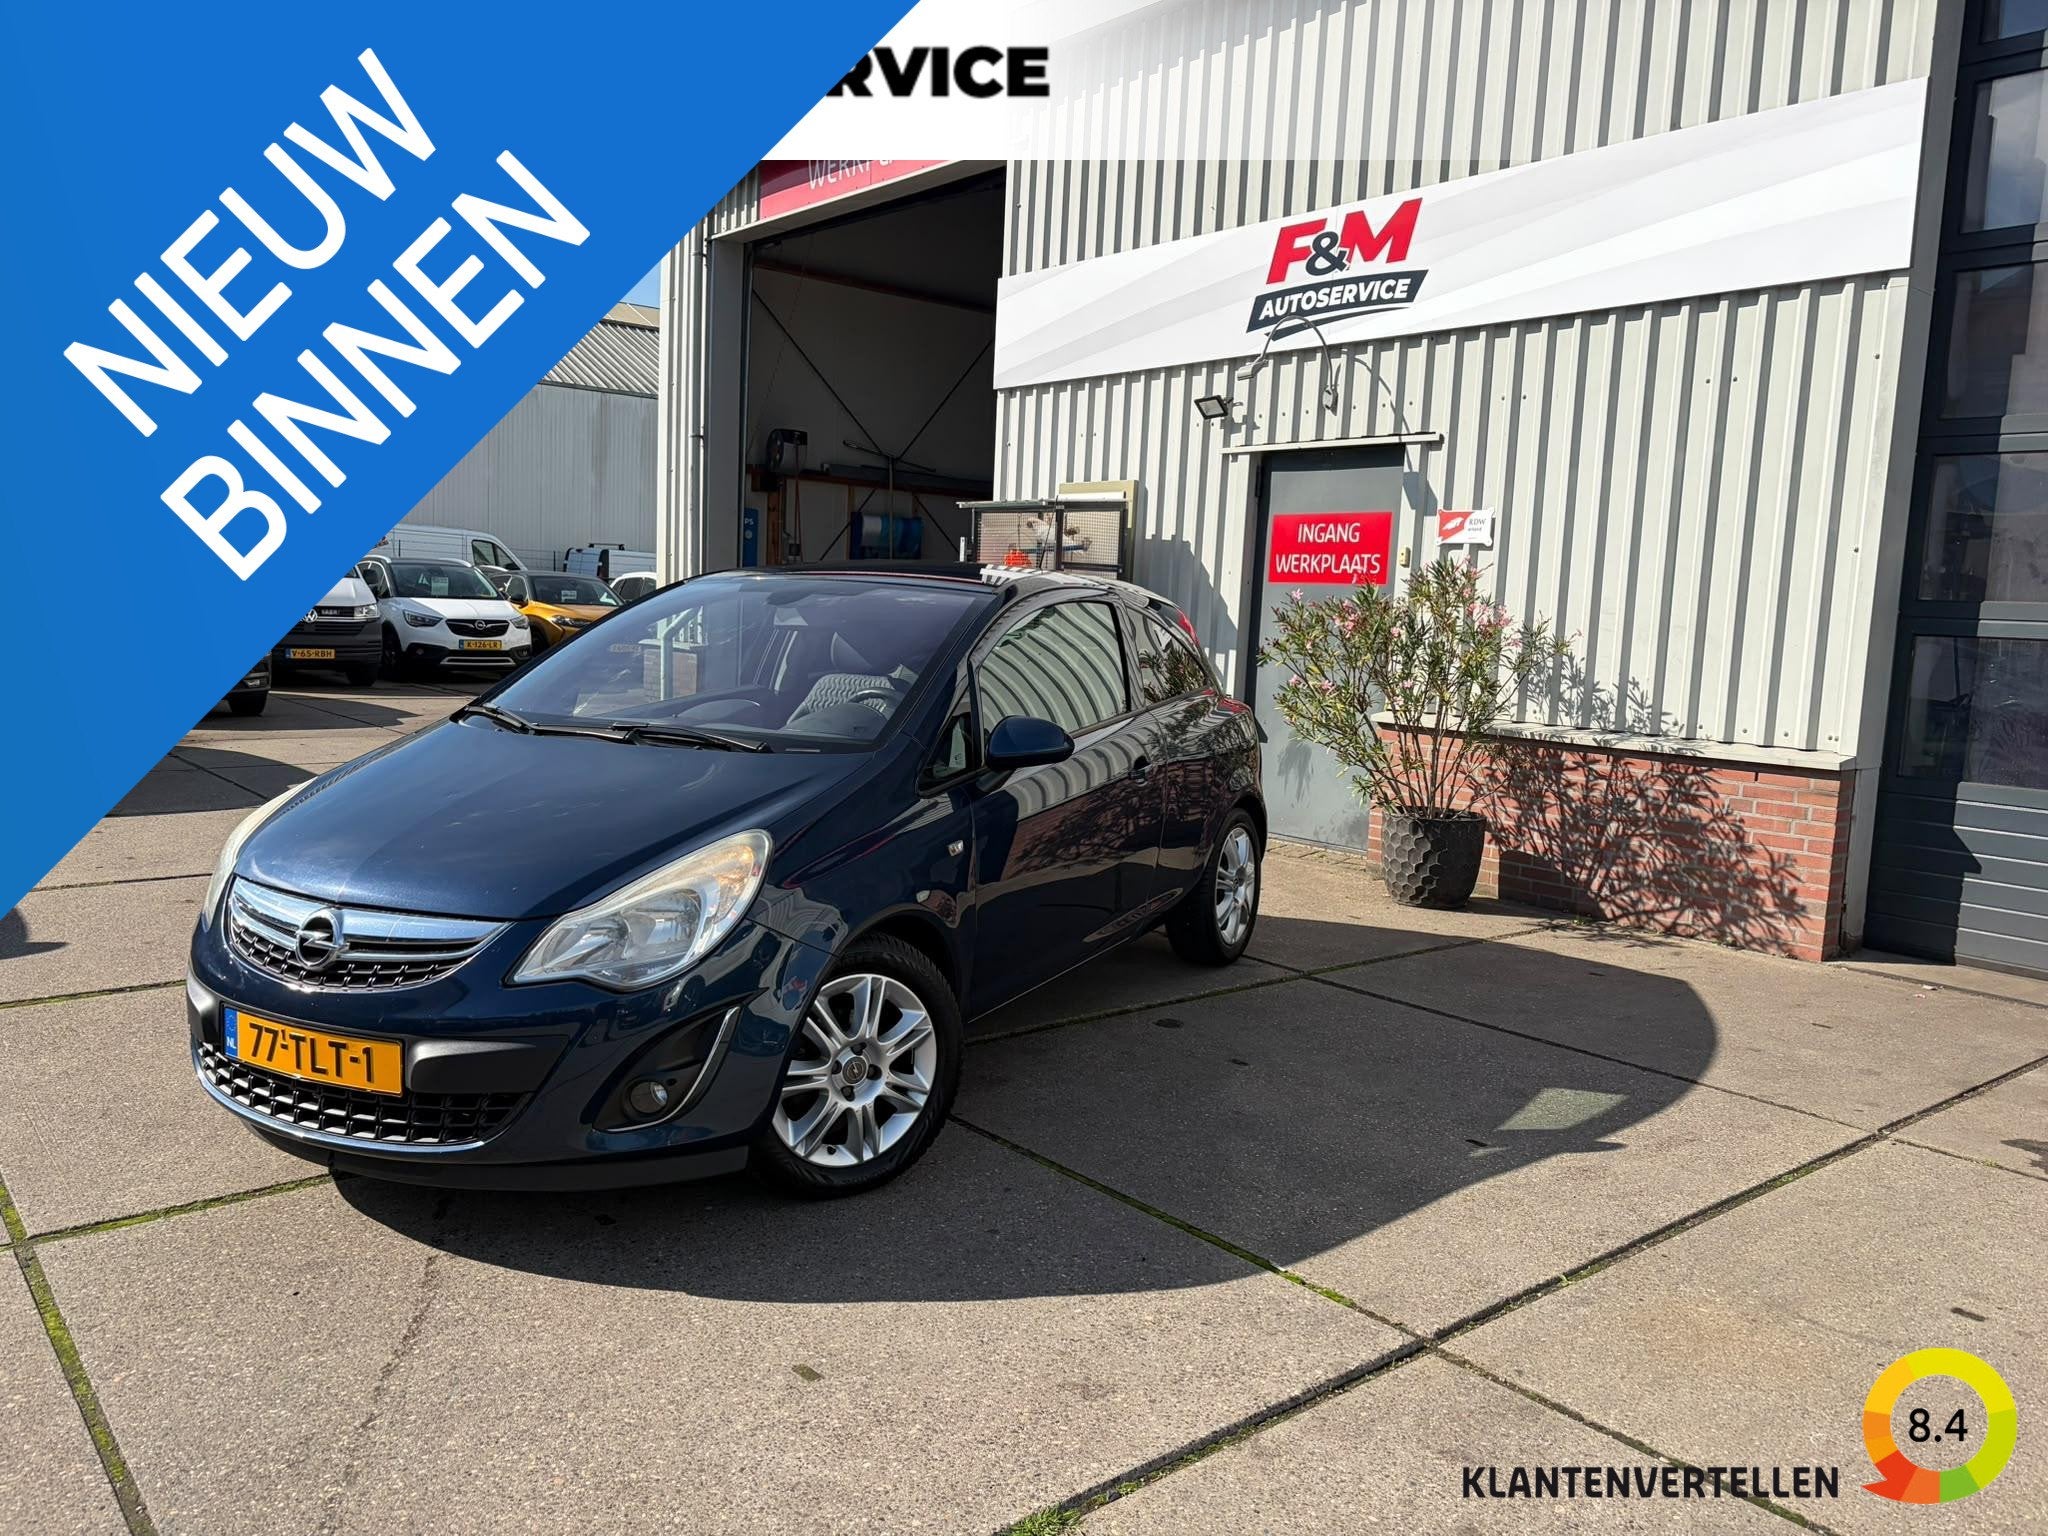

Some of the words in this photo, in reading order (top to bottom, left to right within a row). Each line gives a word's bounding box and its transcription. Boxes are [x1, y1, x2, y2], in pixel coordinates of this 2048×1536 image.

[1266, 197, 1424, 285] F&M
[1259, 278, 1412, 321] AUTOSERVICE
[1297, 522, 1361, 543] INGANG
[1275, 553, 1381, 575] WERKPLAATS
[249, 1022, 376, 1083] 77-TLT-1
